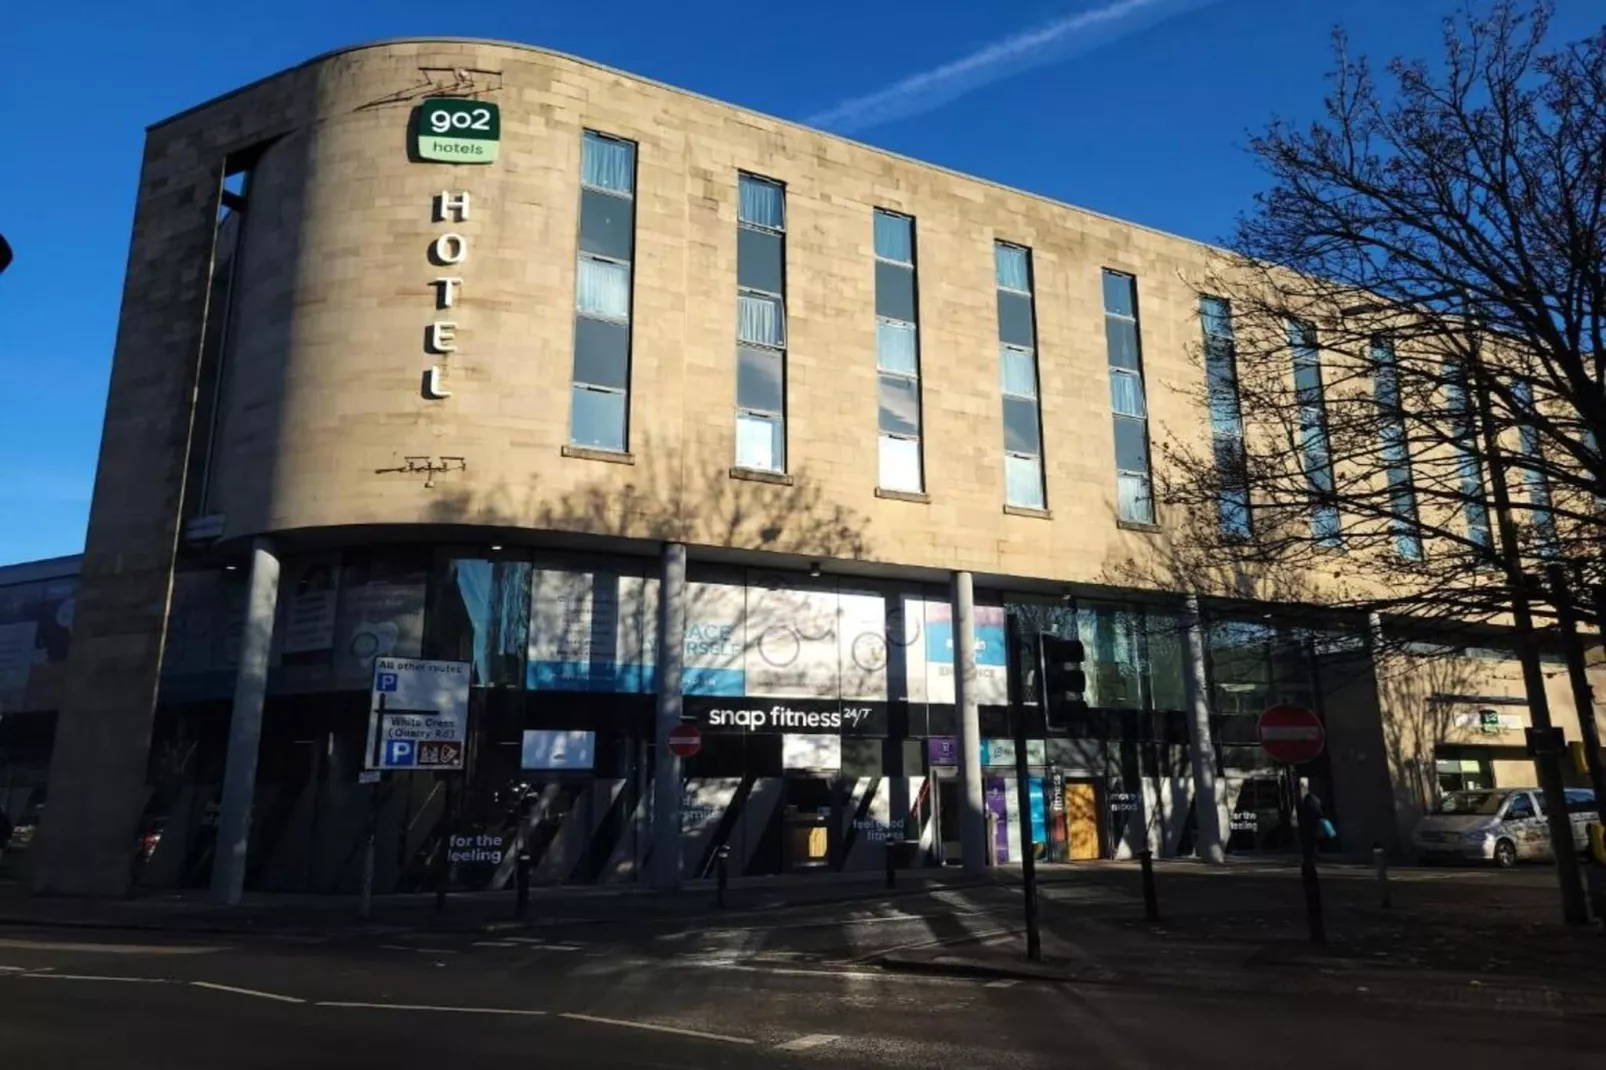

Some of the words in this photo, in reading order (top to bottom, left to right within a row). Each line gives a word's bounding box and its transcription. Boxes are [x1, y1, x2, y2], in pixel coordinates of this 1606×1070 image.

[431, 108, 491, 133] go2
[433, 140, 484, 155] hotels
[431, 190, 470, 397] HOTEL
[379, 660, 395, 669] All
[397, 662, 425, 671] other
[428, 664, 463, 673] routes
[382, 675, 395, 690] P
[391, 716, 421, 727] White
[425, 718, 455, 728] Cross
[709, 708, 766, 731] snap
[770, 706, 841, 728] fitness
[843, 708, 872, 727] 24/7
[389, 728, 431, 739] (Quarry
[435, 729, 455, 739] Rd)
[392, 742, 411, 763] P
[449, 834, 474, 847] for
[476, 834, 502, 847] the
[447, 848, 503, 865] feeling
